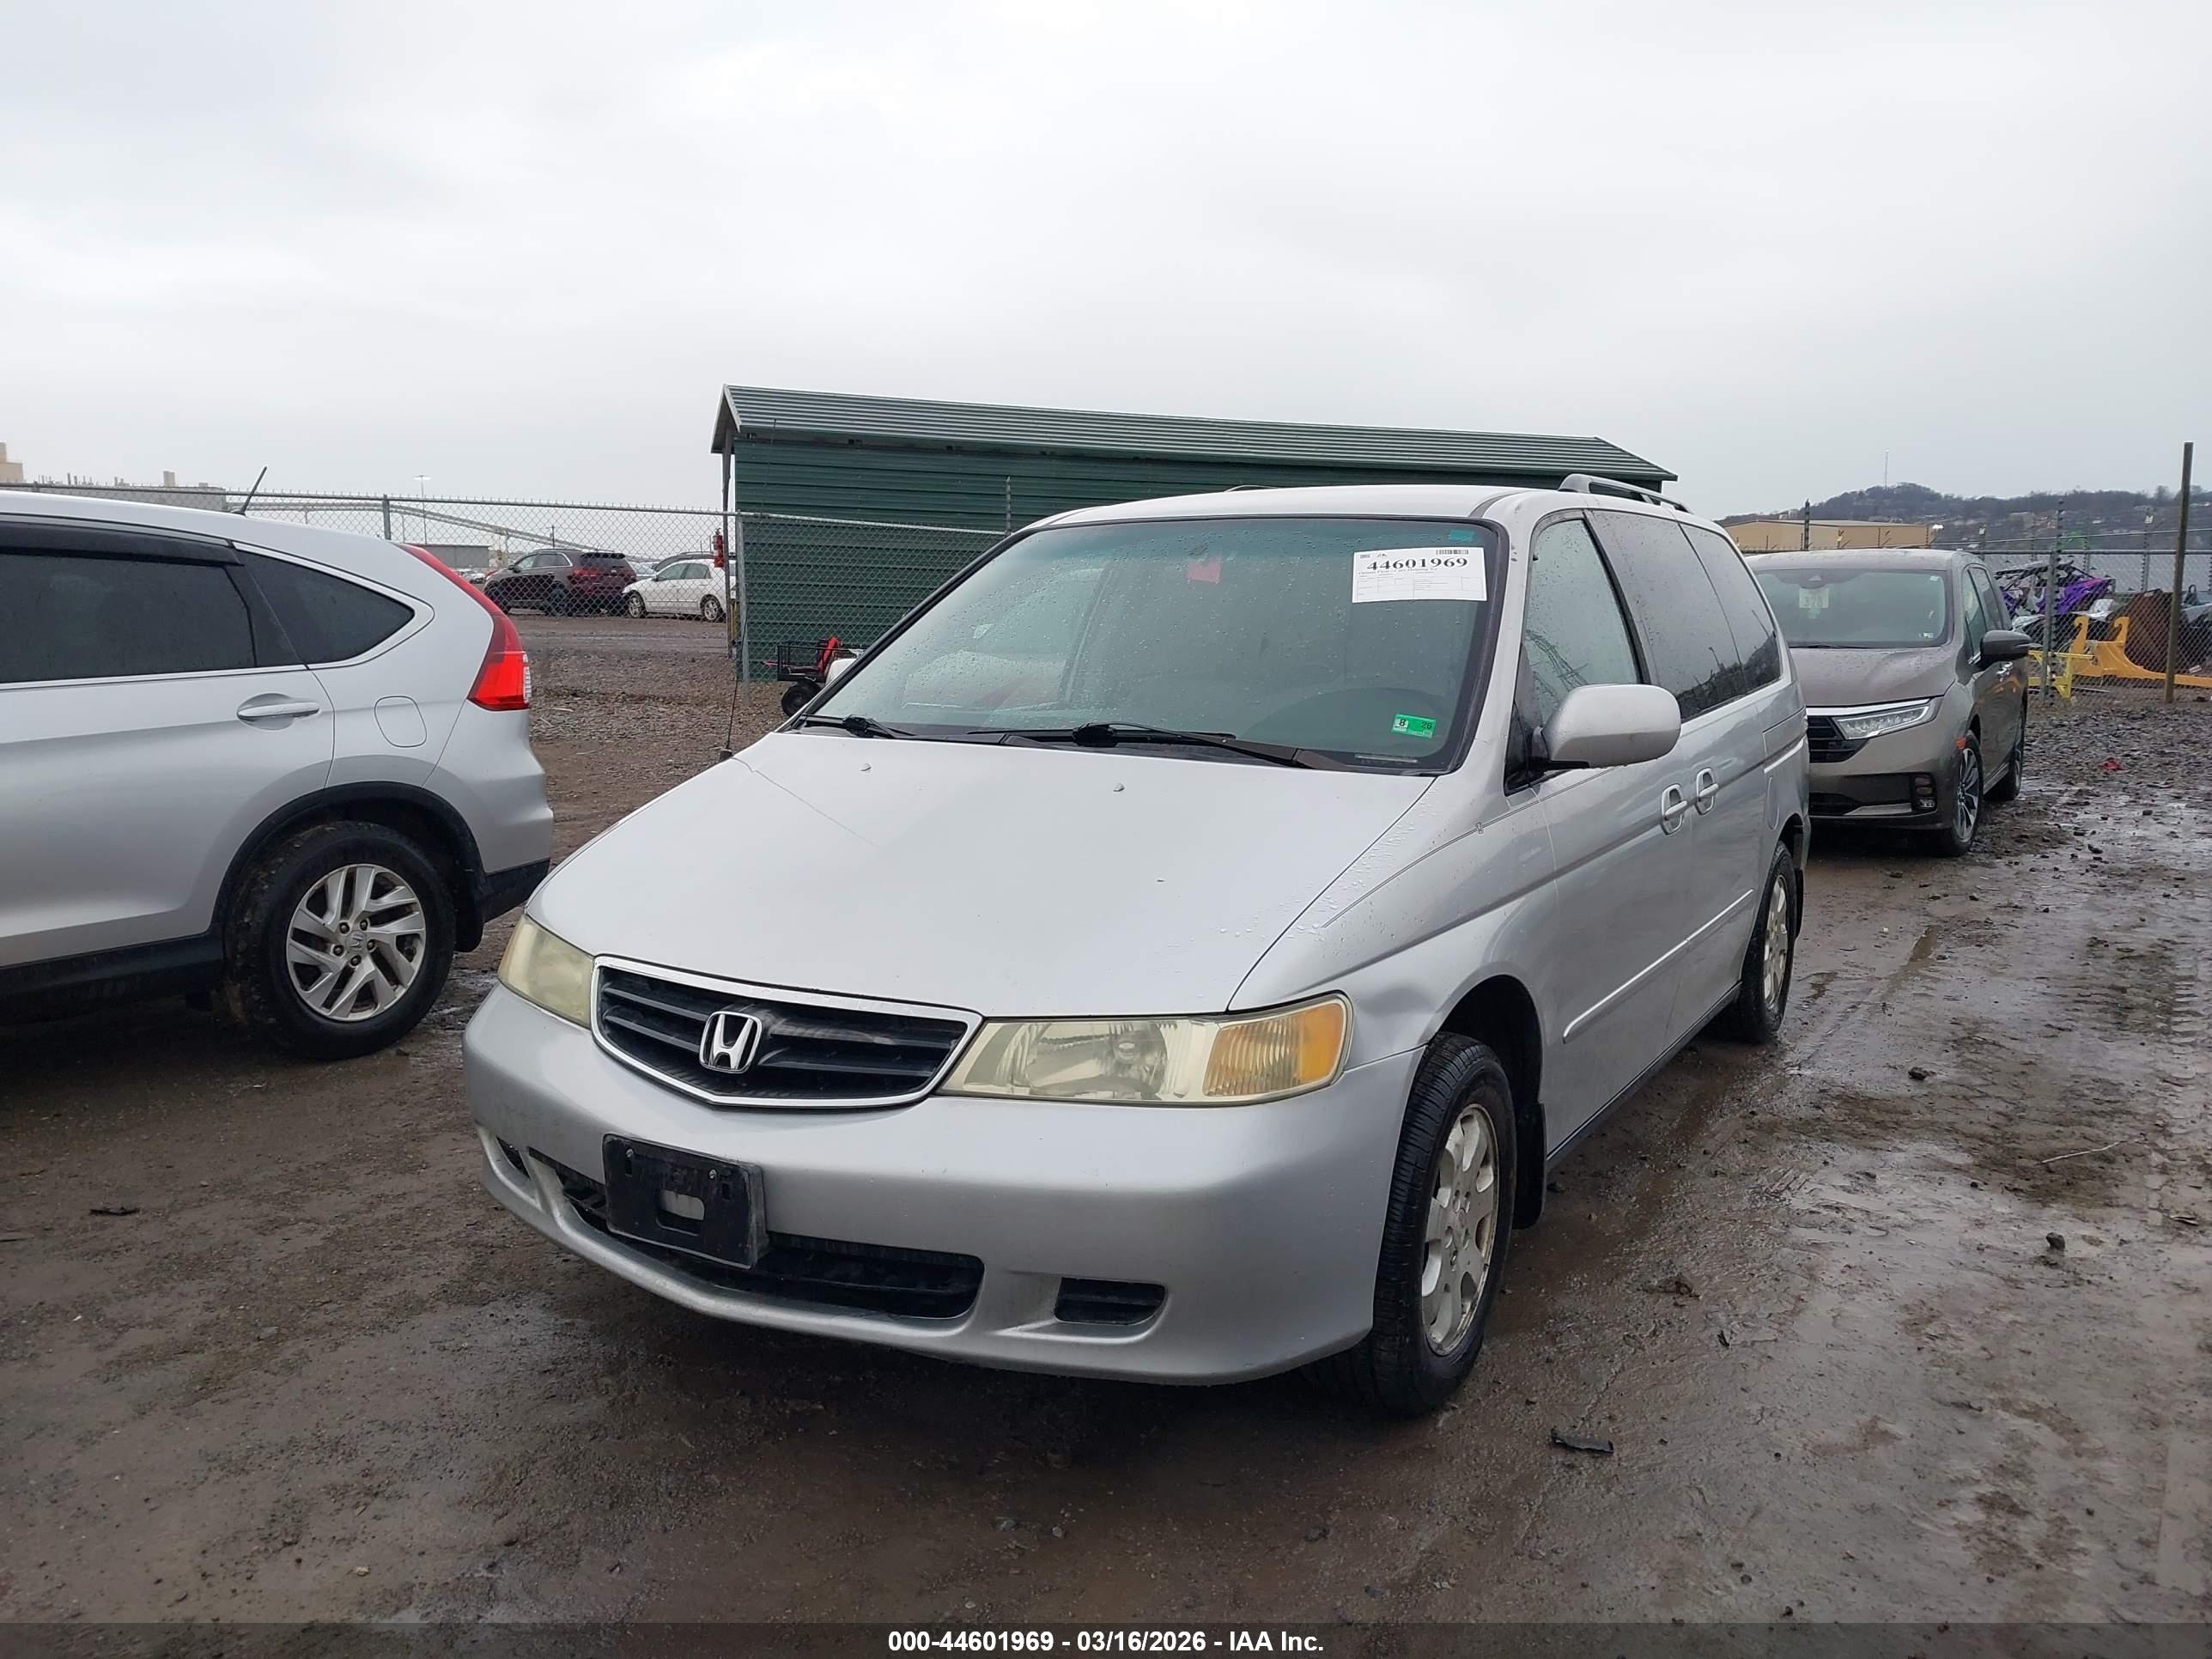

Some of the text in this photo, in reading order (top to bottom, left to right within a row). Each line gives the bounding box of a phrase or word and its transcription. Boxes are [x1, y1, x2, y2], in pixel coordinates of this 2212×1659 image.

[1366, 557, 1468, 571] 44601969
[1399, 719, 1432, 730] 8 26
